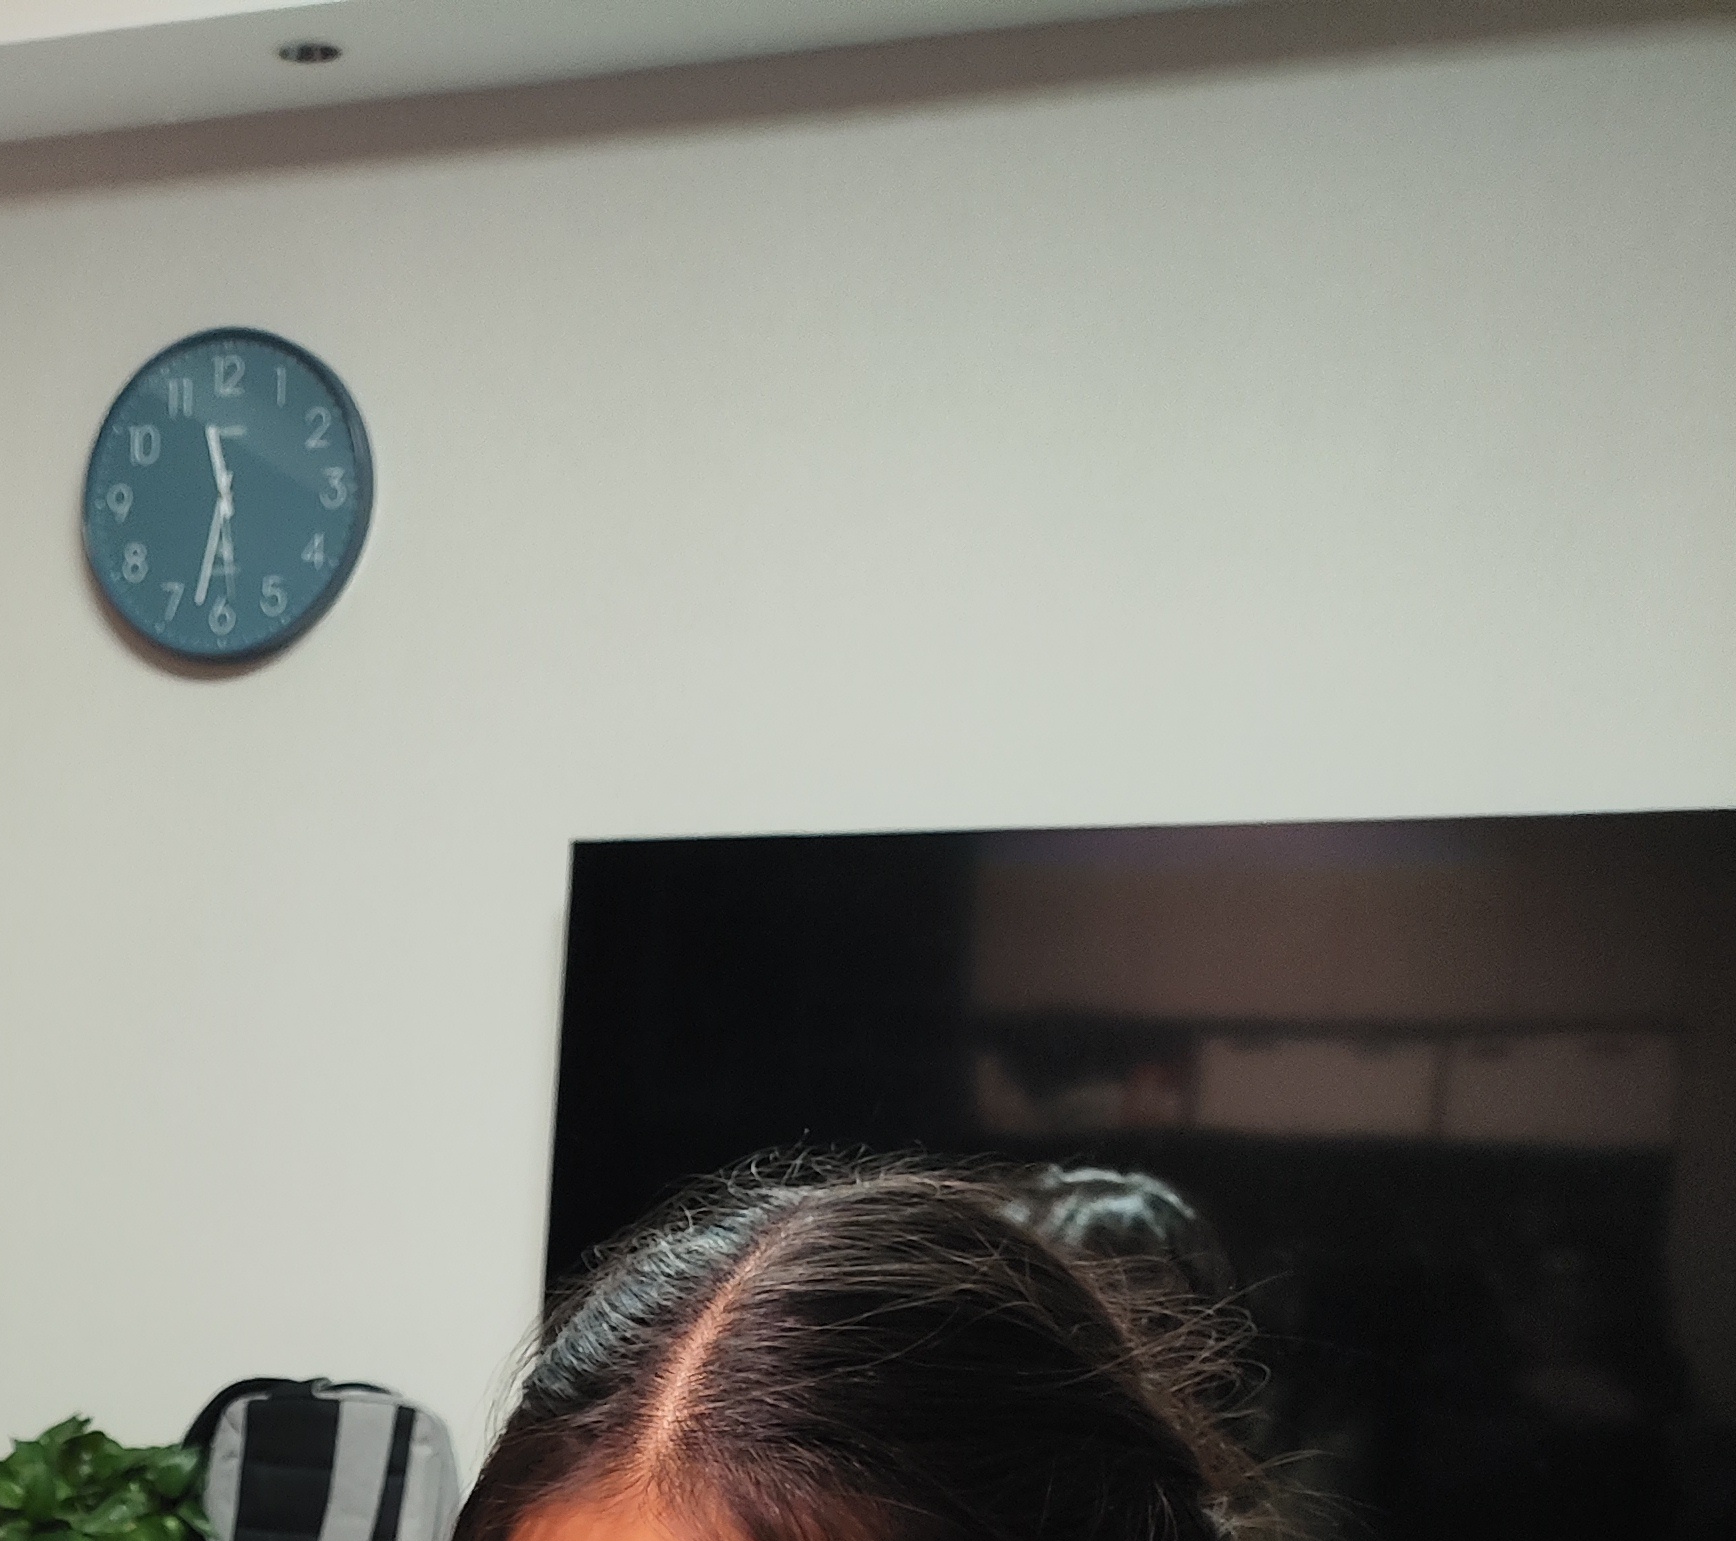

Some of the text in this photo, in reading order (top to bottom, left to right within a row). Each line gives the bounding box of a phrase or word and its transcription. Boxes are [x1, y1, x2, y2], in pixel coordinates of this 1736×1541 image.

[216, 354, 246, 397] 12
[276, 366, 287, 408] 1
[168, 378, 193, 420] 11
[130, 423, 161, 467] 10
[305, 406, 331, 449] 2
[106, 483, 134, 523] 9
[320, 466, 347, 510] 3
[122, 542, 149, 583] 8
[301, 532, 325, 570] 4
[161, 581, 184, 621] 7
[208, 596, 237, 635] 6
[260, 574, 288, 617] 5
